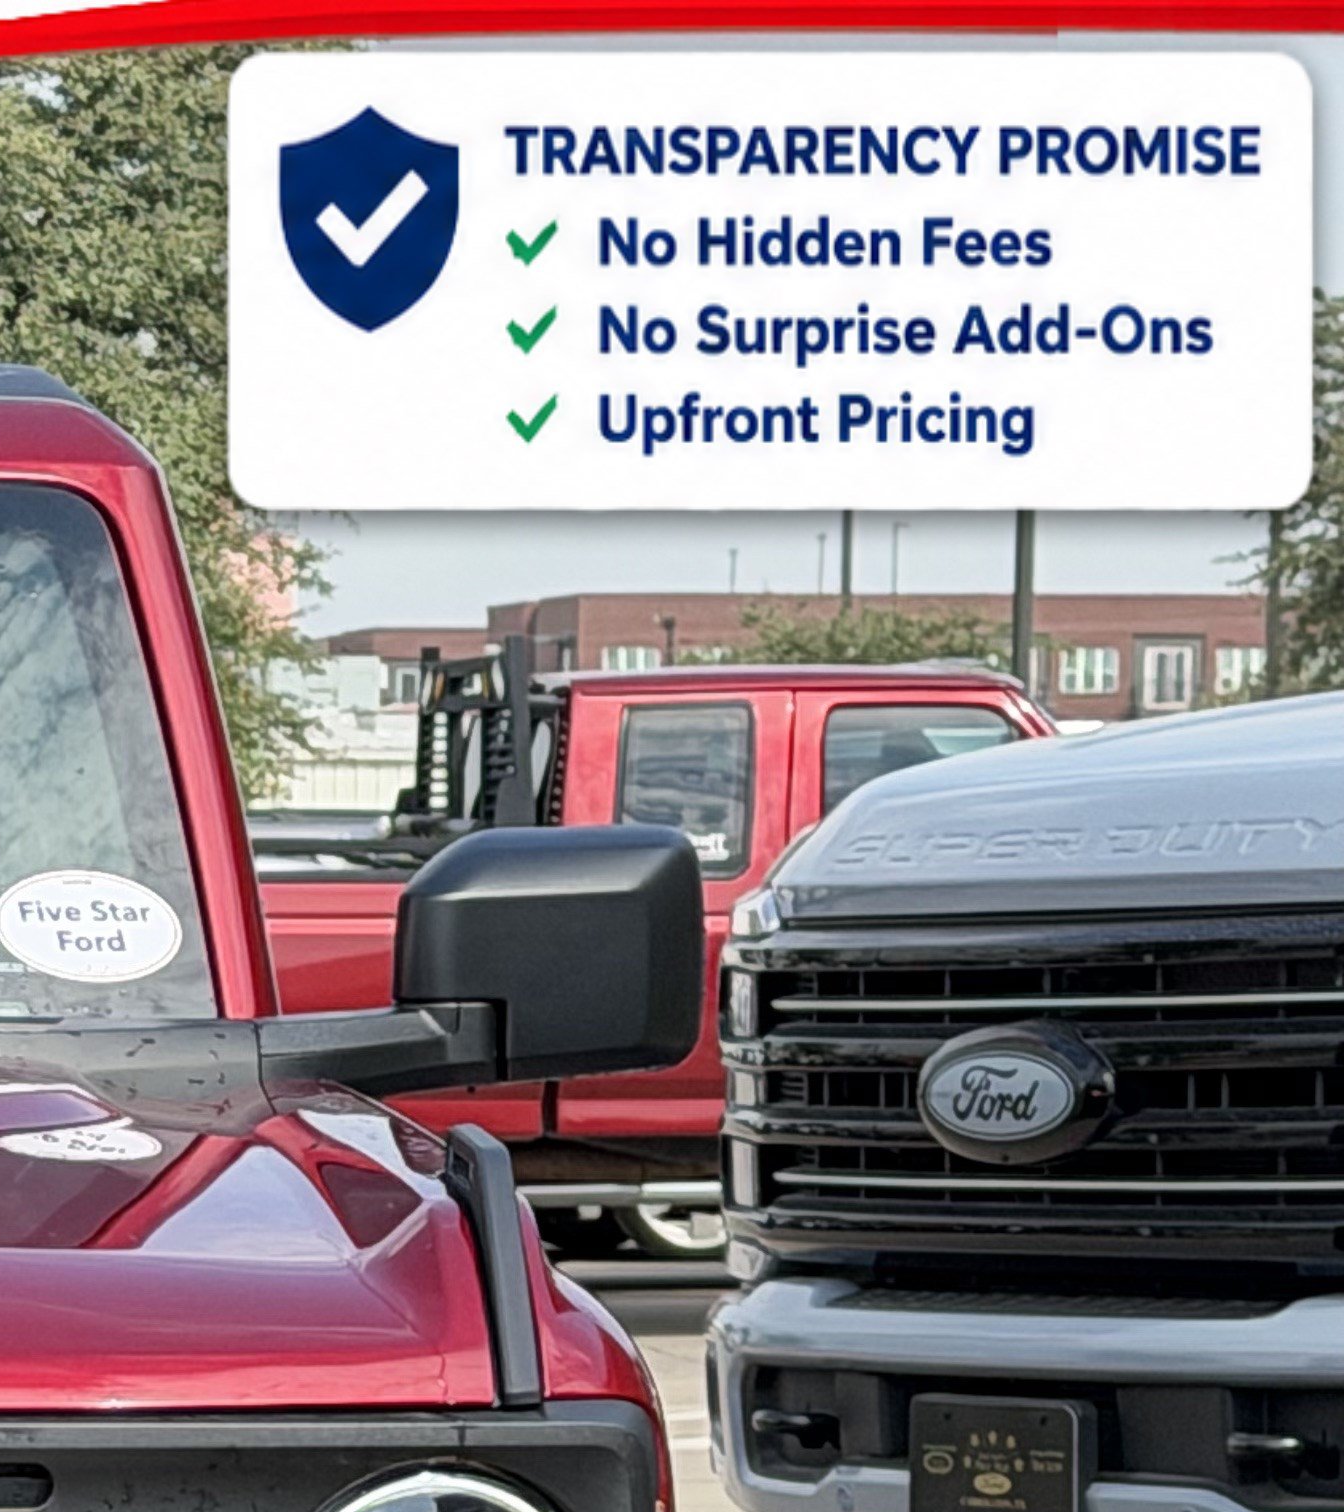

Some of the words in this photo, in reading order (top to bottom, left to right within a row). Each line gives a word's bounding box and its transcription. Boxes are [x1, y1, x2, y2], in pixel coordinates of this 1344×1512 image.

[834, 827, 1082, 868] SUPER
[1106, 817, 1344, 859] DUTY
[17, 900, 81, 922] Five
[90, 900, 150, 922] Star
[56, 929, 127, 952] Ford
[952, 1064, 1042, 1123] Ford
